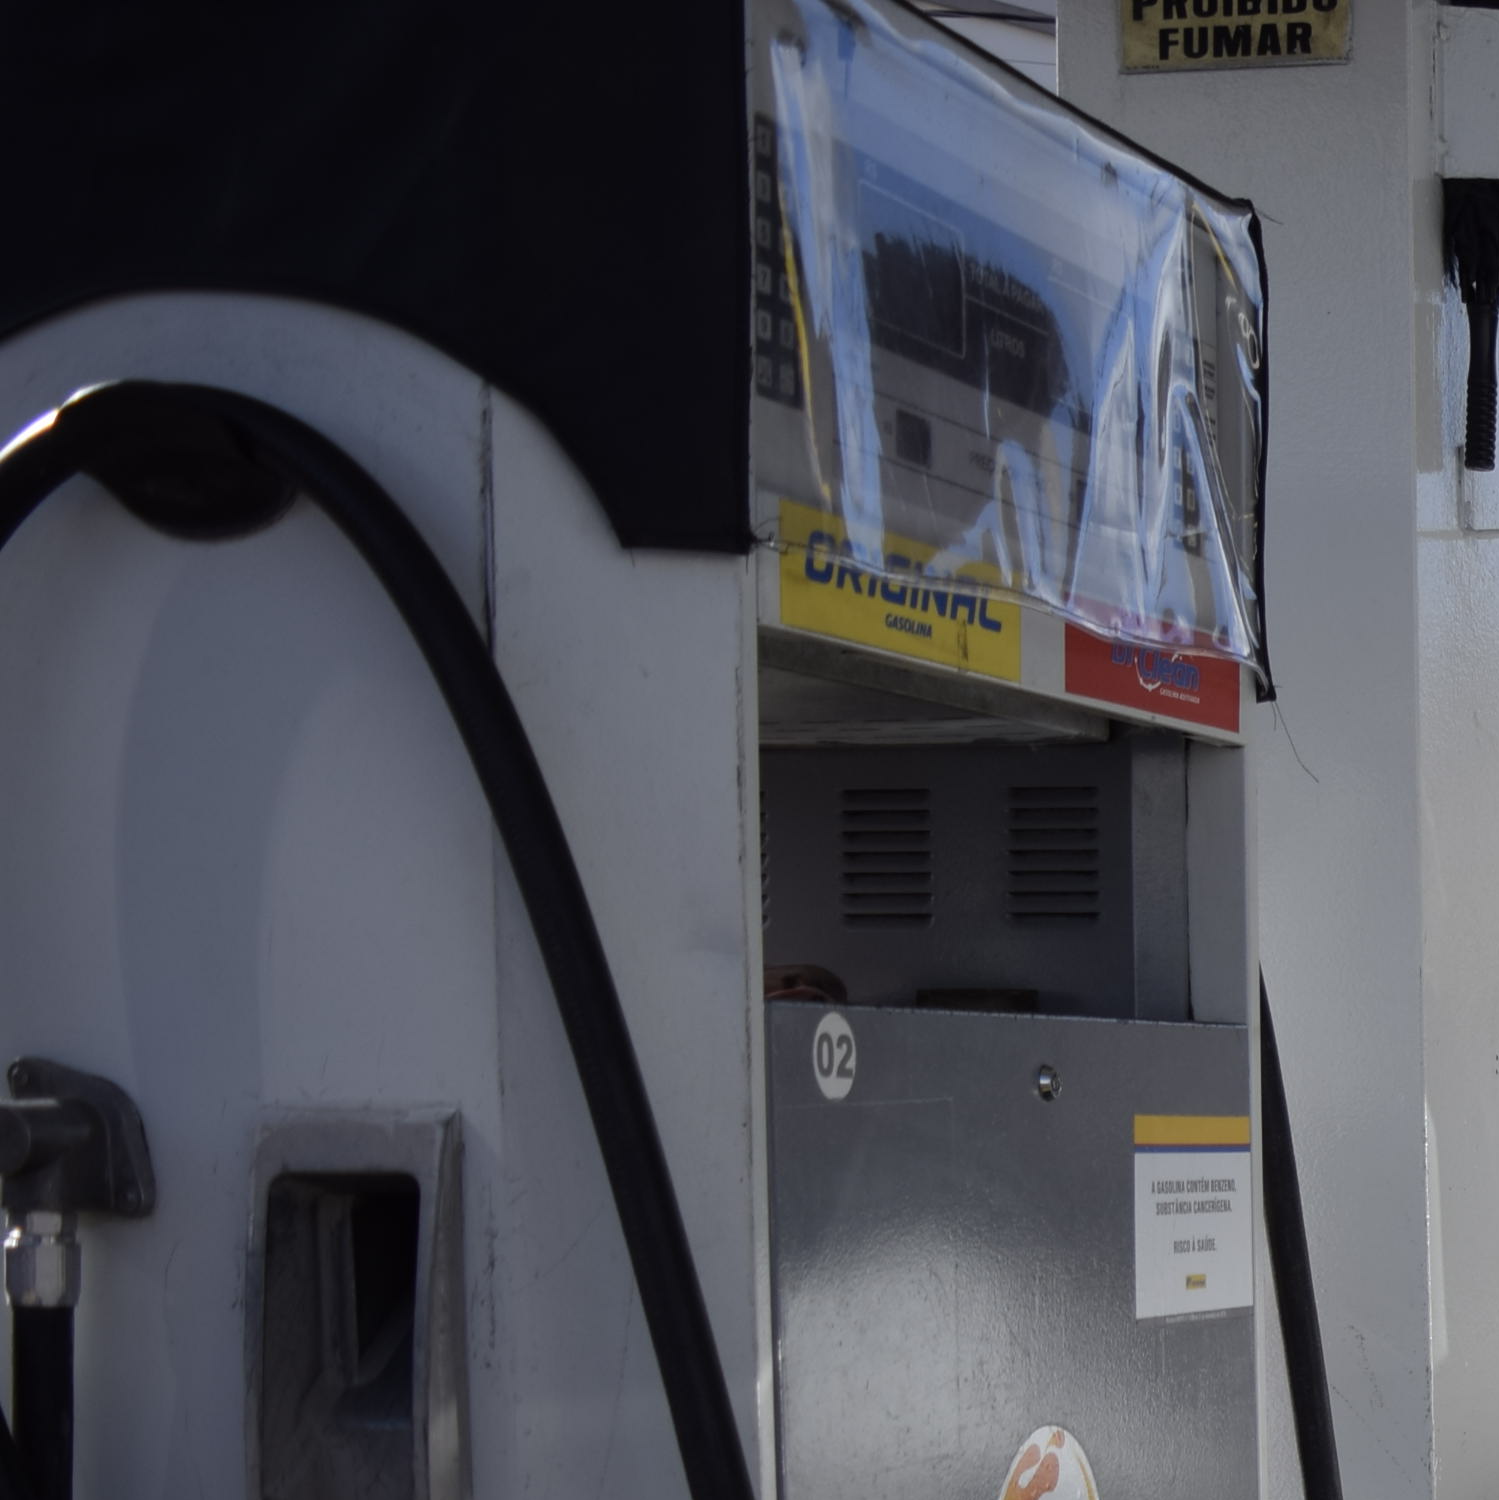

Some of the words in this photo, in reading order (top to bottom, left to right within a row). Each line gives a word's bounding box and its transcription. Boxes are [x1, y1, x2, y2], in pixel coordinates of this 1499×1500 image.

[1158, 22, 1312, 60] FUMAR
[805, 530, 1002, 633] ORIGINAL
[885, 612, 933, 641] GASOLINA
[817, 1032, 853, 1078] 02
[1157, 1180, 1185, 1194] GASOLINA
[1186, 1176, 1210, 1194] CONTÉM
[1174, 1240, 1190, 1254] RISCO
